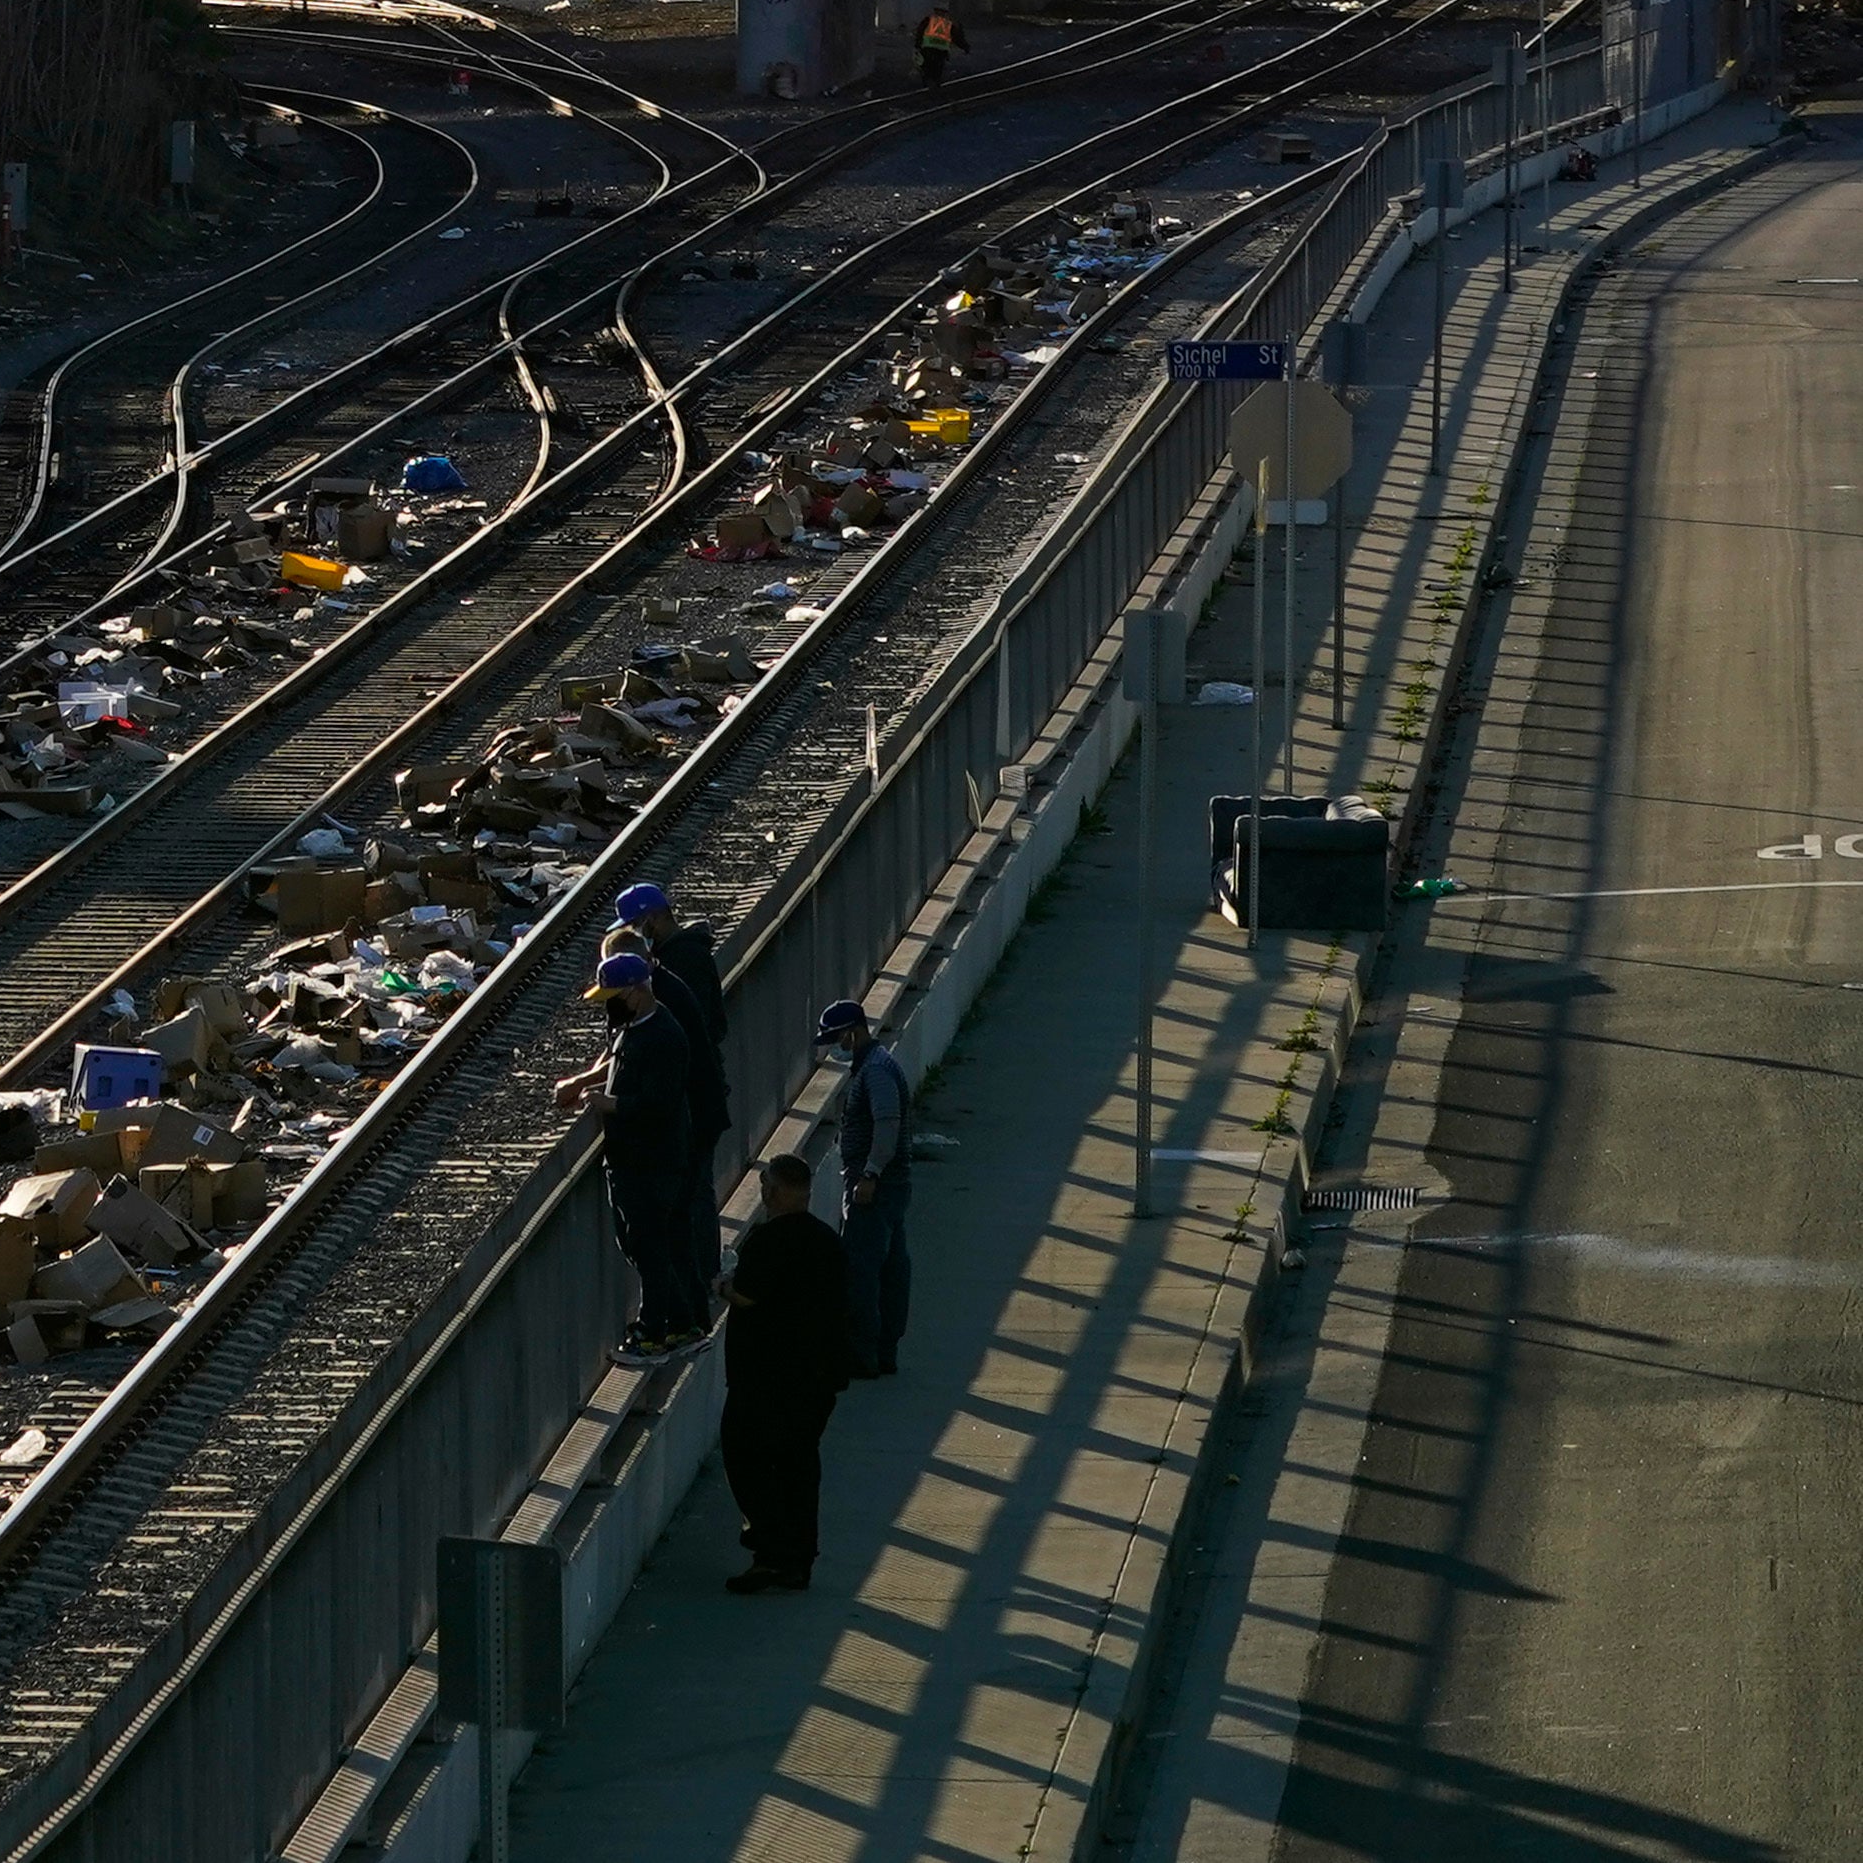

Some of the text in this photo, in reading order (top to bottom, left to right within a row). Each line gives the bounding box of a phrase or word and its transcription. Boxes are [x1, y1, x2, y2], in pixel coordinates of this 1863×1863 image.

[1172, 344, 1279, 365] Sichel St
[1173, 364, 1217, 378] 1700 N
